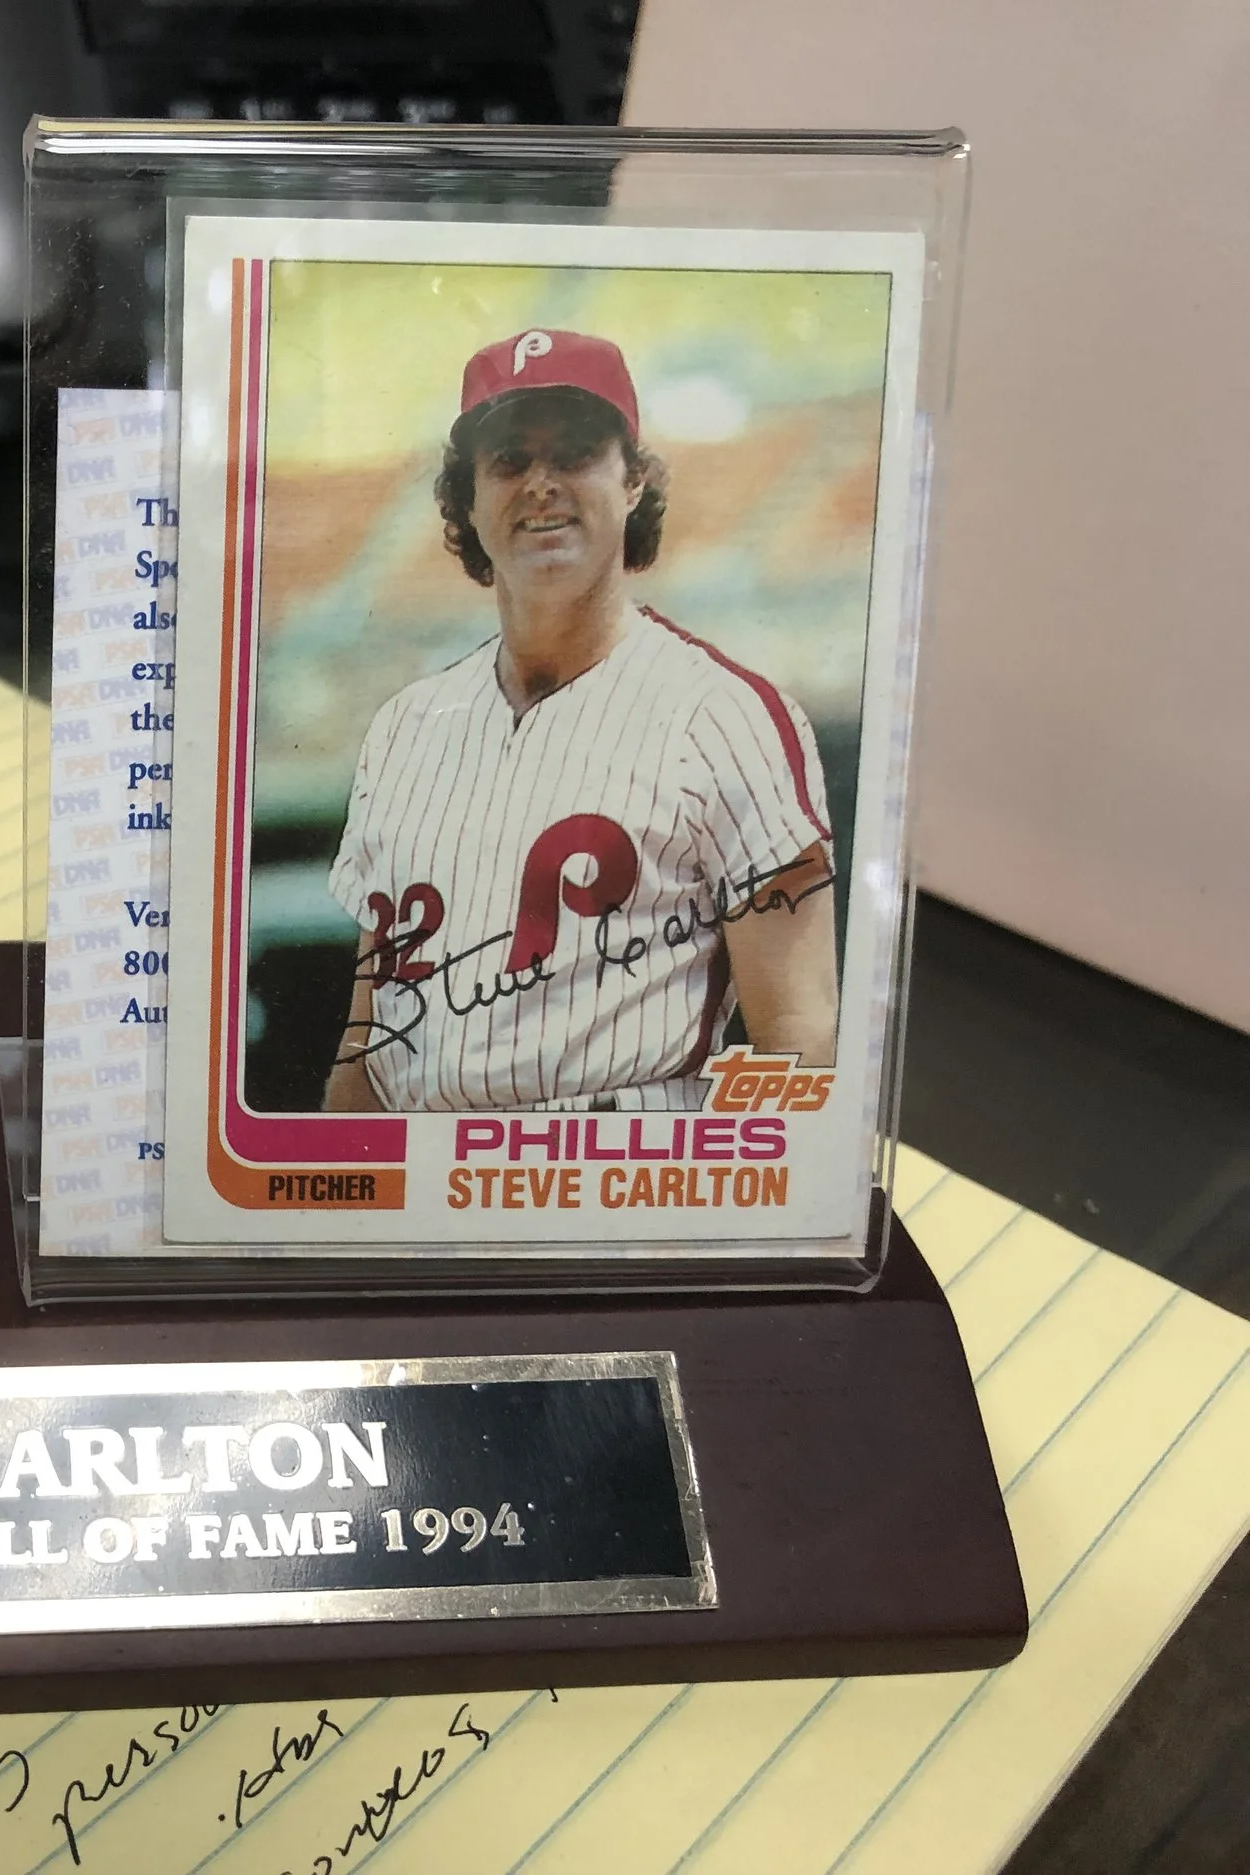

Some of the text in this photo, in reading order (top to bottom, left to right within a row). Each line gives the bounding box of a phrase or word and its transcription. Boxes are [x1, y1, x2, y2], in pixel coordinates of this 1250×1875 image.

[126, 802, 171, 830] ink
[454, 1117, 787, 1162] PHILLIES
[268, 1175, 376, 1201] PITCHER
[447, 1166, 789, 1209] STEVE CARLTON
[82, 1514, 165, 1566] OF
[187, 1510, 358, 1561] FAME
[379, 1502, 526, 1556] 1994
